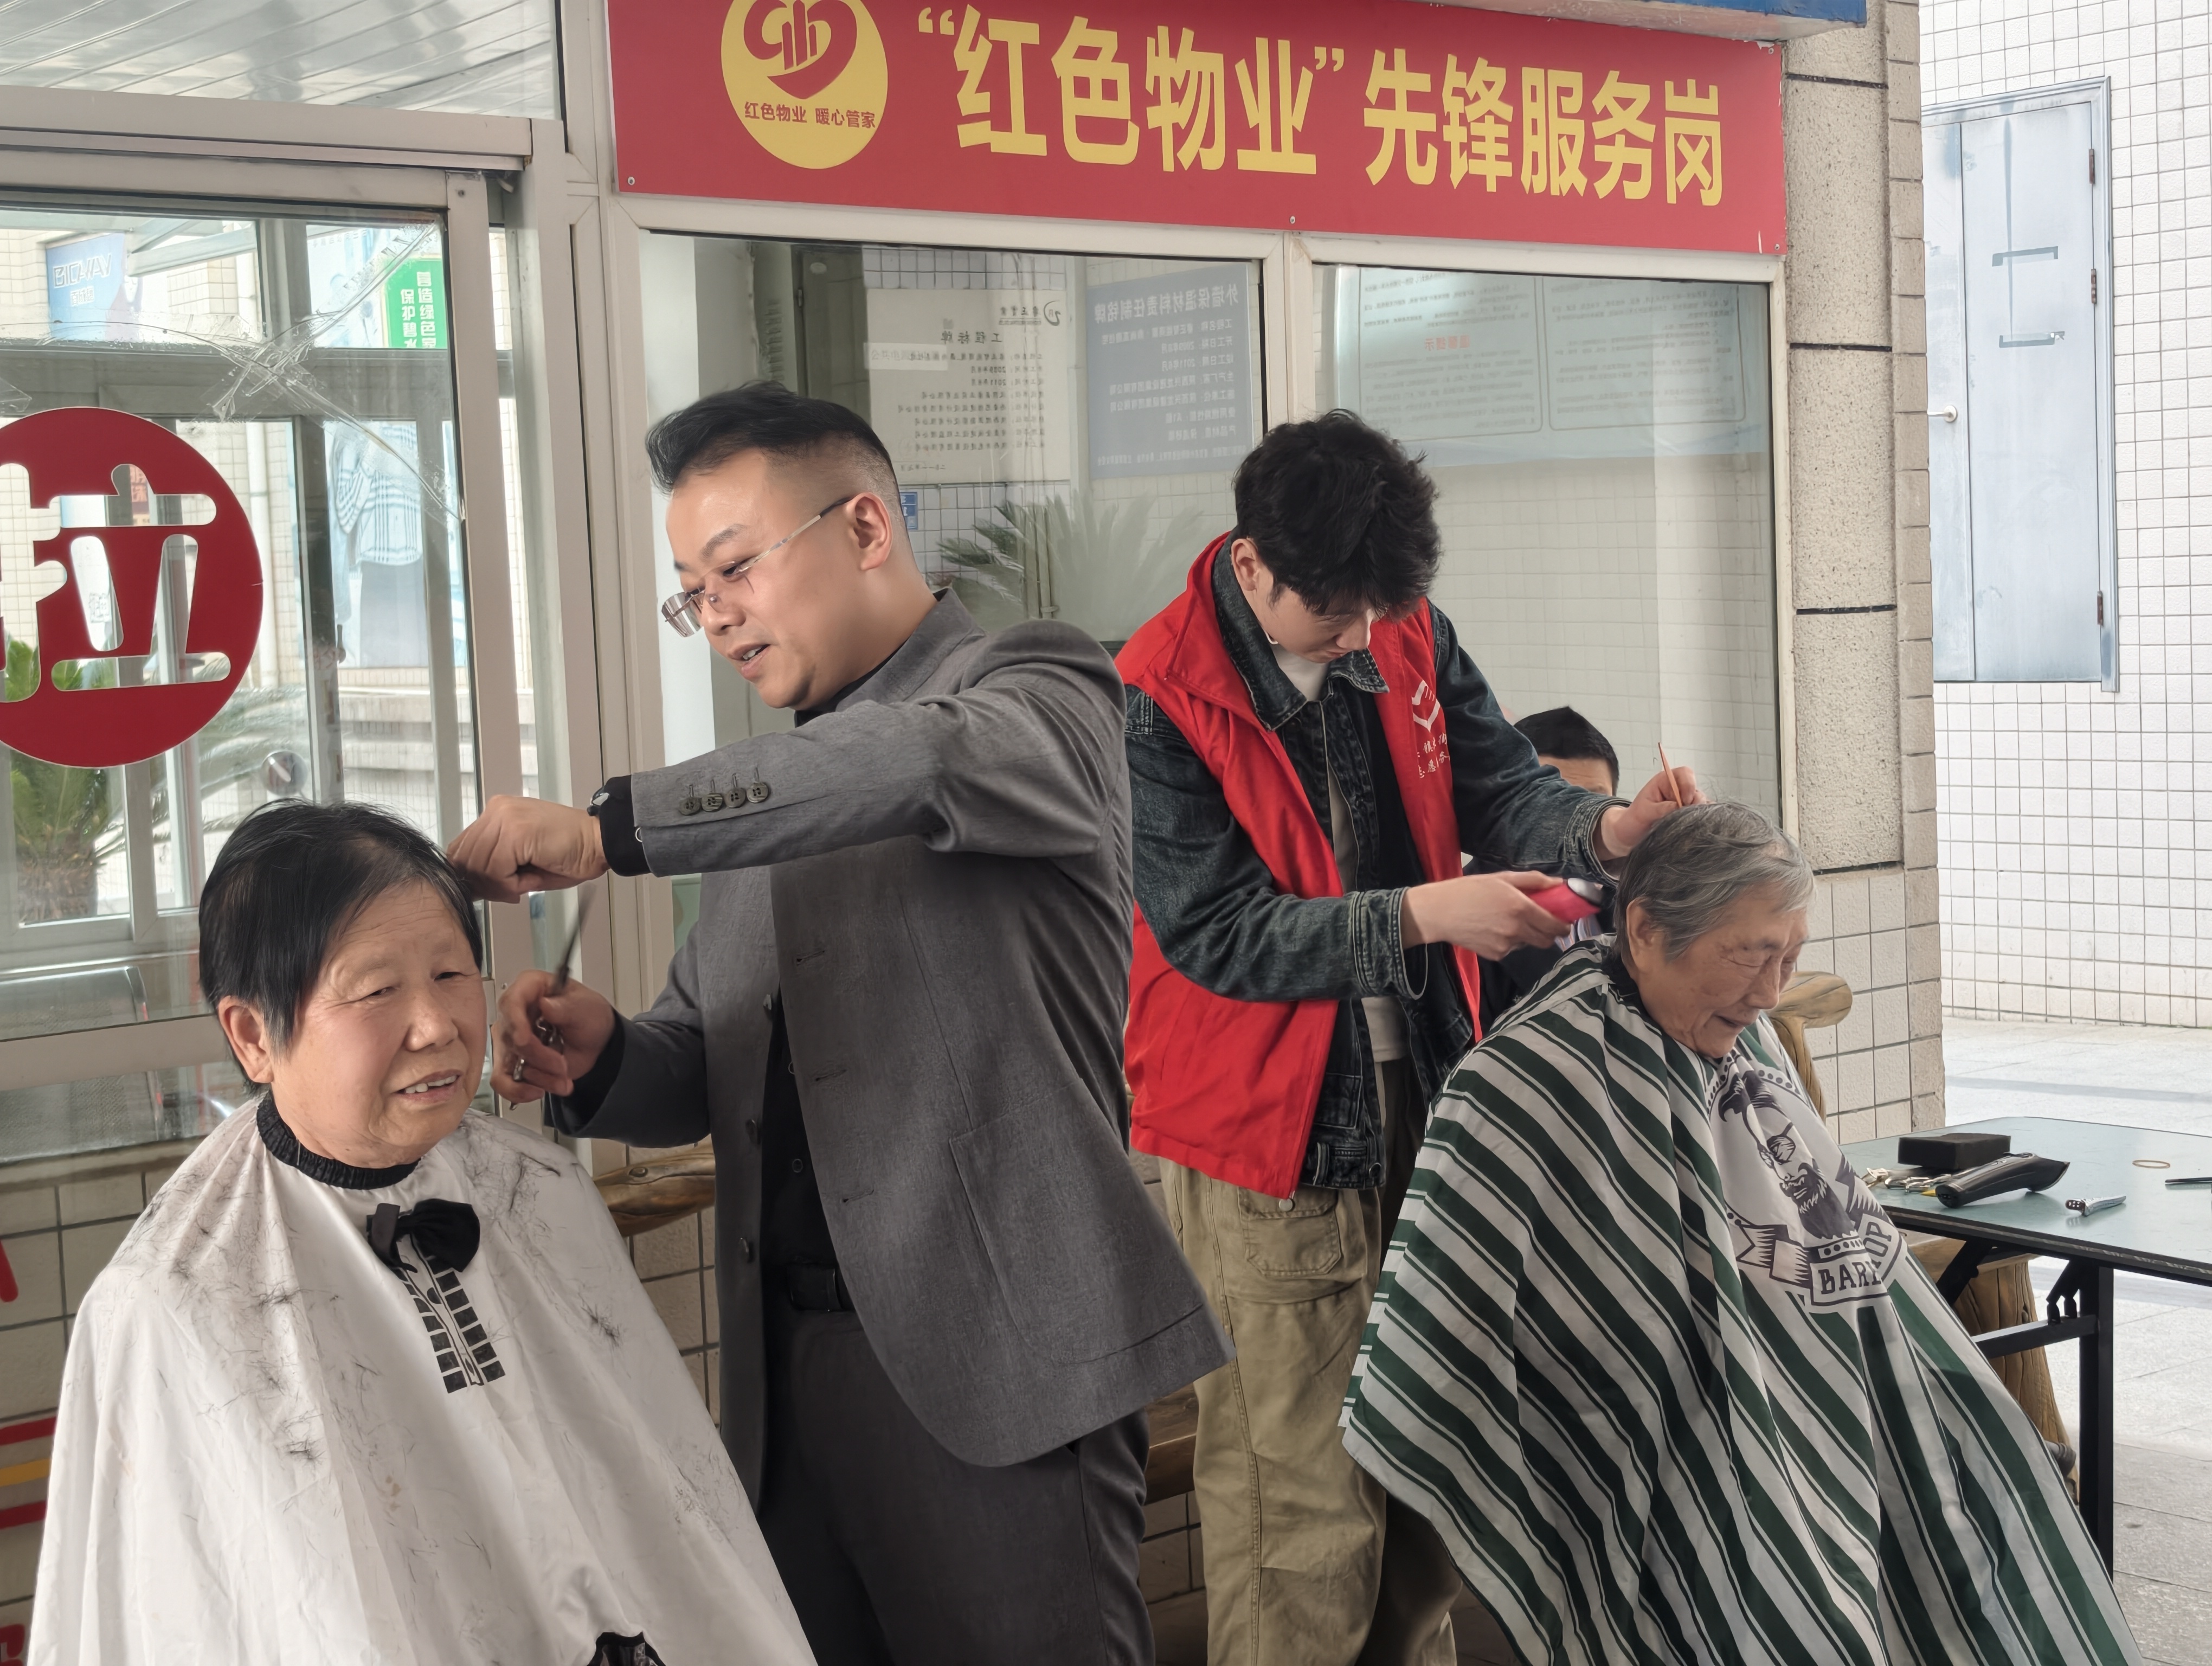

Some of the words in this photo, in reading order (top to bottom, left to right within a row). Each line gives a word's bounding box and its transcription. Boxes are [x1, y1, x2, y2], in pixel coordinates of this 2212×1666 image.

[744, 101, 807, 124] 红色物业
[815, 107, 876, 129] 暖心管家
